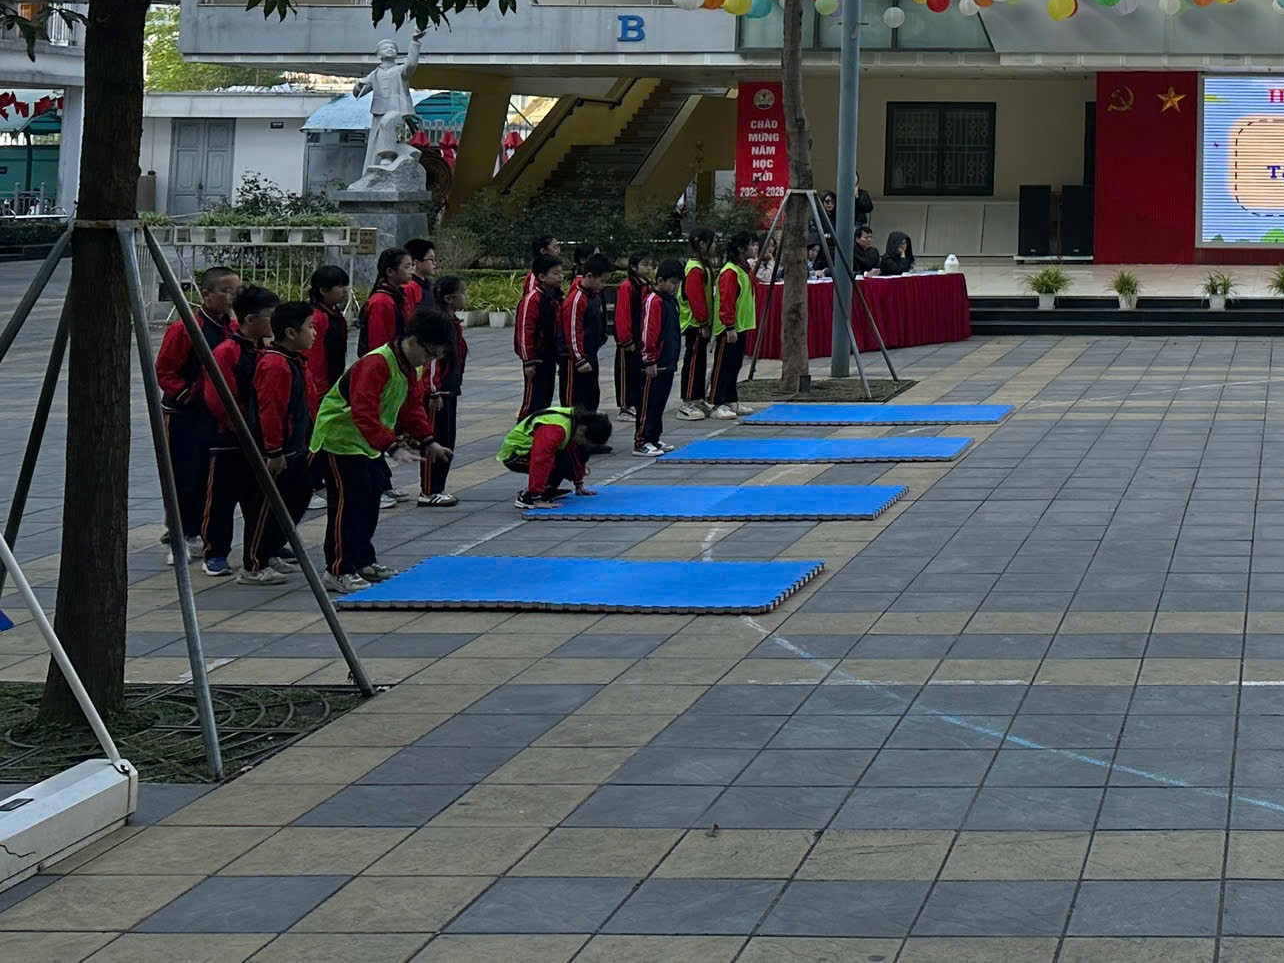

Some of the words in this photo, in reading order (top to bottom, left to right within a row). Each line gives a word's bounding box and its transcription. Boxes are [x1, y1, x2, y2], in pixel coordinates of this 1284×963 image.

[617, 15, 646, 43] B
[750, 118, 779, 129] CHÀO
[748, 131, 780, 142] MỪNG
[751, 145, 776, 155] NĂM
[752, 159, 774, 170] HỌC
[765, 186, 785, 197] 2026
